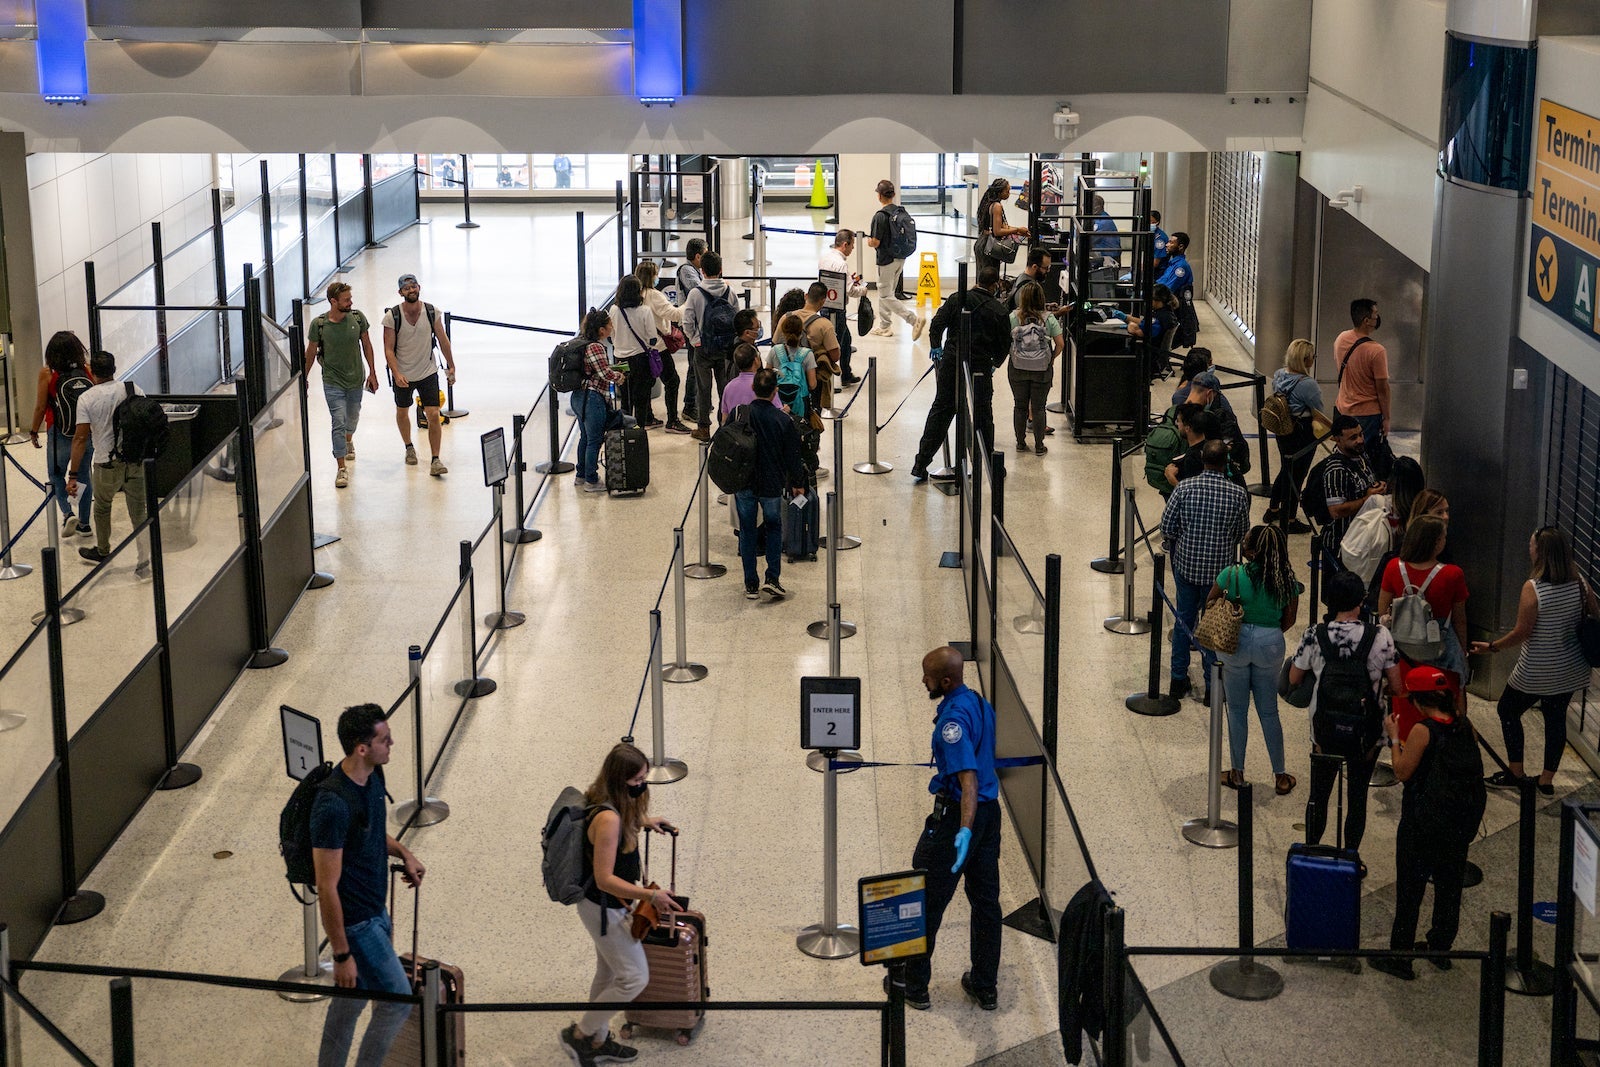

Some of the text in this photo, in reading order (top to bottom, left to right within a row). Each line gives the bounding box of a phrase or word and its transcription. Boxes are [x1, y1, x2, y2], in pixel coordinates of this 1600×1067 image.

[1575, 264, 1591, 313] A
[827, 721, 837, 736] 2
[300, 756, 307, 770] 1
